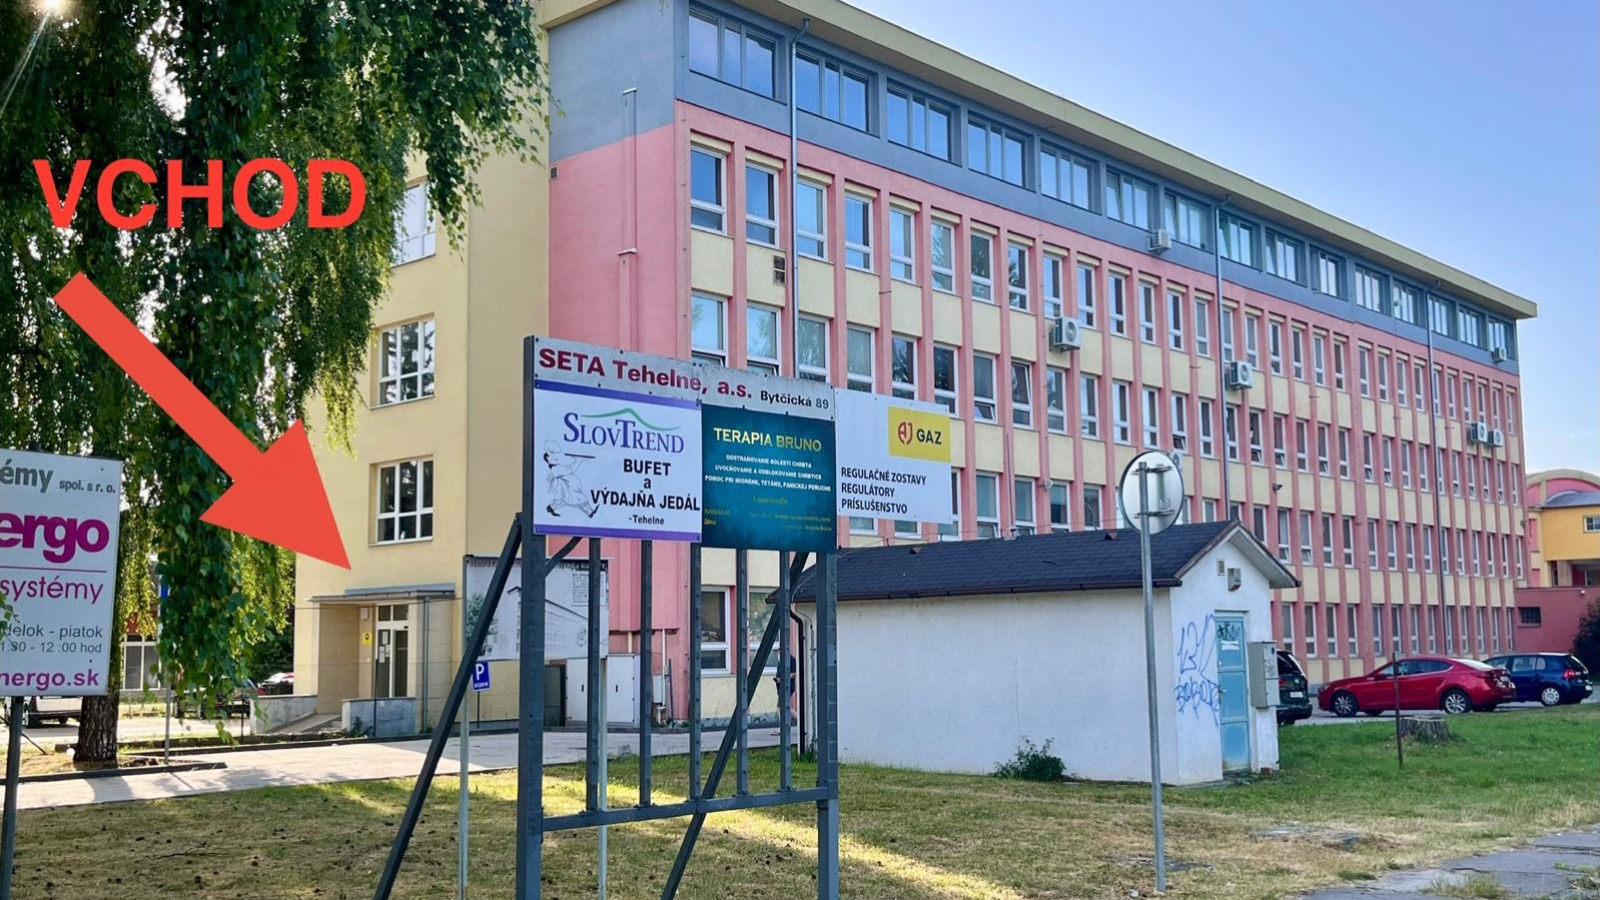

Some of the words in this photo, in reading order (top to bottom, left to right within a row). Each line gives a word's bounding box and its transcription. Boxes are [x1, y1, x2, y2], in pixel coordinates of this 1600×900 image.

[539, 348, 605, 377] SETA
[612, 359, 708, 395] Tehelne,
[717, 380, 752, 398] a.s.
[760, 390, 812, 407] Bytčická
[815, 398, 829, 410] 89
[713, 427, 773, 447] TERAPIA
[776, 434, 822, 452] BRUNO
[916, 428, 942, 445] GAZ
[623, 458, 671, 476] BUFET
[643, 478, 652, 489] a
[841, 467, 890, 482] REGULAČNÉ
[891, 472, 927, 485] ZOSTAVY
[59, 479, 84, 492] spol.
[87, 483, 93, 491] s
[95, 484, 103, 492] r.
[106, 484, 116, 493] o.
[808, 484, 831, 492] PORUCHE
[841, 482, 895, 497] REGULÁTORY
[590, 487, 655, 508] VÝDAJŇA
[659, 493, 700, 511] JEDÁL
[841, 497, 908, 514] PRÍSLUŠENSTVO
[0, 575, 103, 604] systémy
[60, 625, 103, 640] piatok
[40, 641, 54, 652] 12
[80, 643, 102, 653] hod
[475, 663, 485, 680] P
